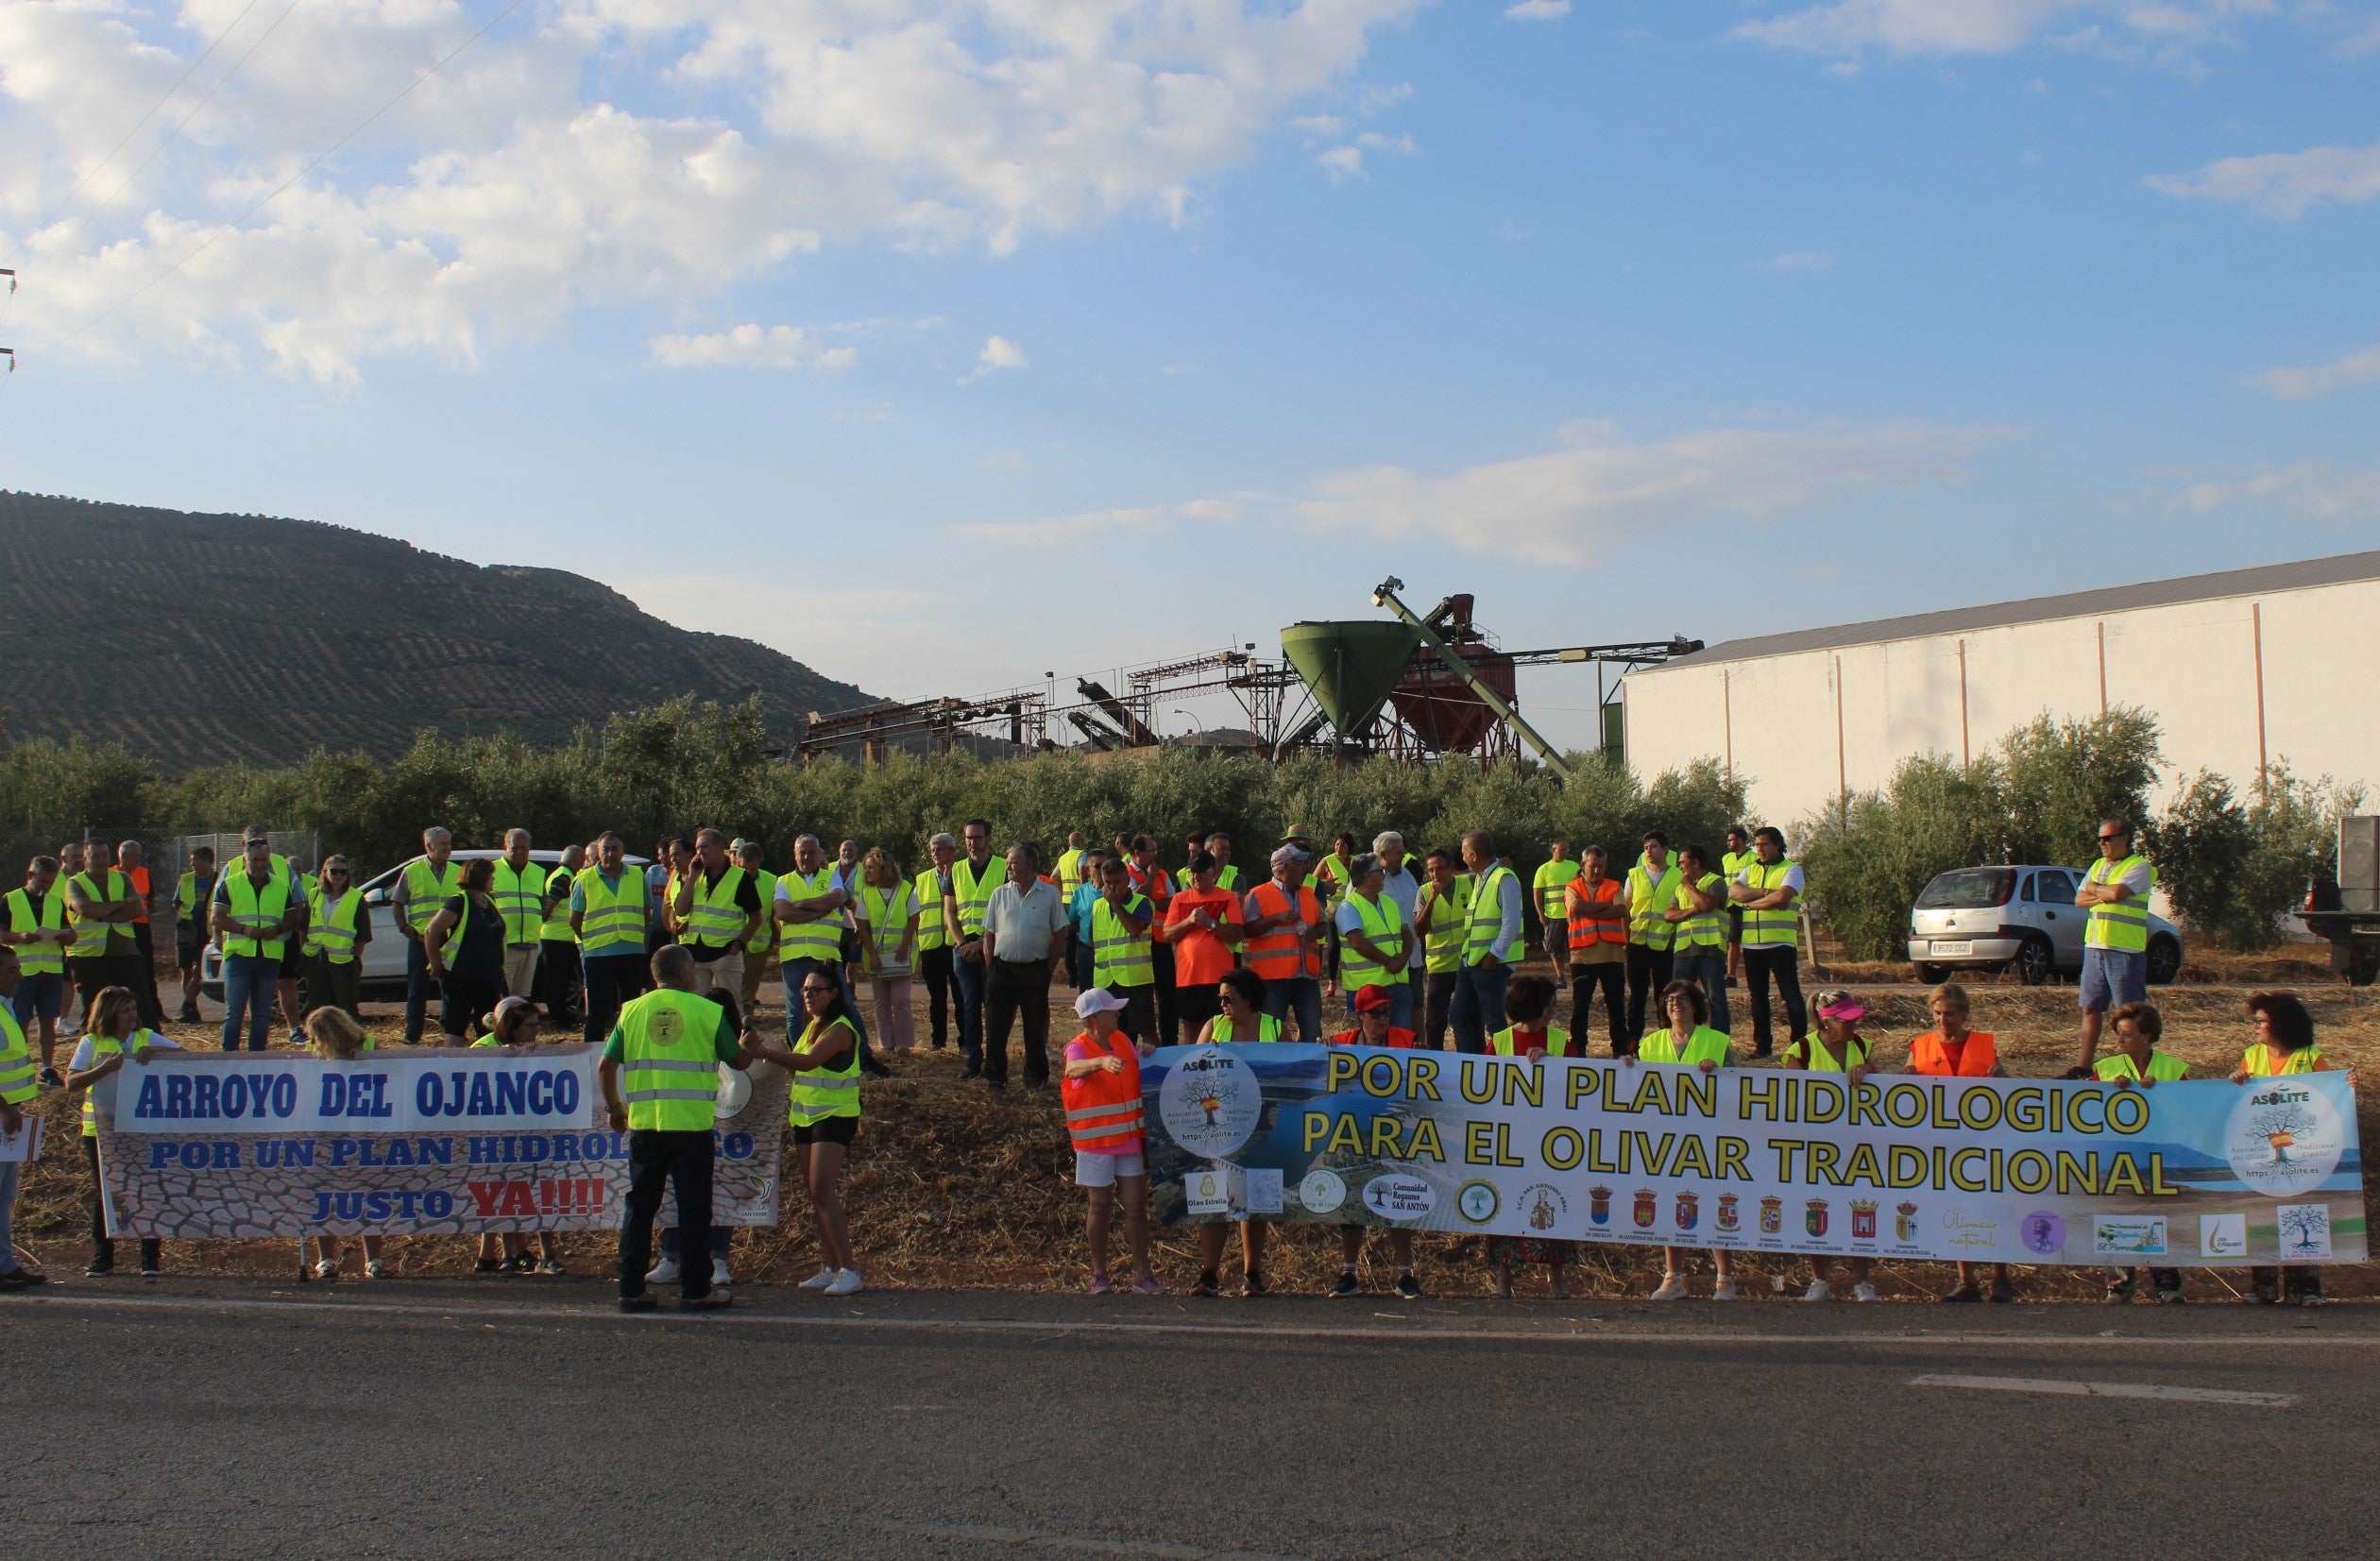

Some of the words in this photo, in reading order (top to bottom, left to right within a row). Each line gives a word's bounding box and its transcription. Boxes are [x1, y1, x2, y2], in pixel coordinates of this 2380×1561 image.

[1182, 1059, 1234, 1073] ASOLITE
[134, 1073, 298, 1119] ARROYO
[319, 1073, 393, 1117] DEL
[416, 1069, 580, 1118] OJANCO
[1326, 1050, 1443, 1102] POR
[1460, 1060, 1545, 1108] UN
[1565, 1065, 1718, 1118] PLAN
[1739, 1076, 2150, 1135] HIDROLOGICO
[2251, 1092, 2310, 1106] ASOLITE
[149, 1140, 242, 1170] POR
[255, 1138, 316, 1169] UN
[331, 1137, 454, 1168] PLAN
[1302, 1111, 1447, 1163] PARA
[1464, 1120, 1524, 1168] EL
[1540, 1125, 1755, 1182] OLIVAR
[1767, 1138, 2181, 1196] TRADICIONAL
[1393, 1182, 1428, 1193] Comunidad
[1393, 1192, 1420, 1201] Regantes
[312, 1189, 454, 1222] JUSTO
[468, 1178, 605, 1218] YA!!!!
[1392, 1201, 1405, 1210] SAN
